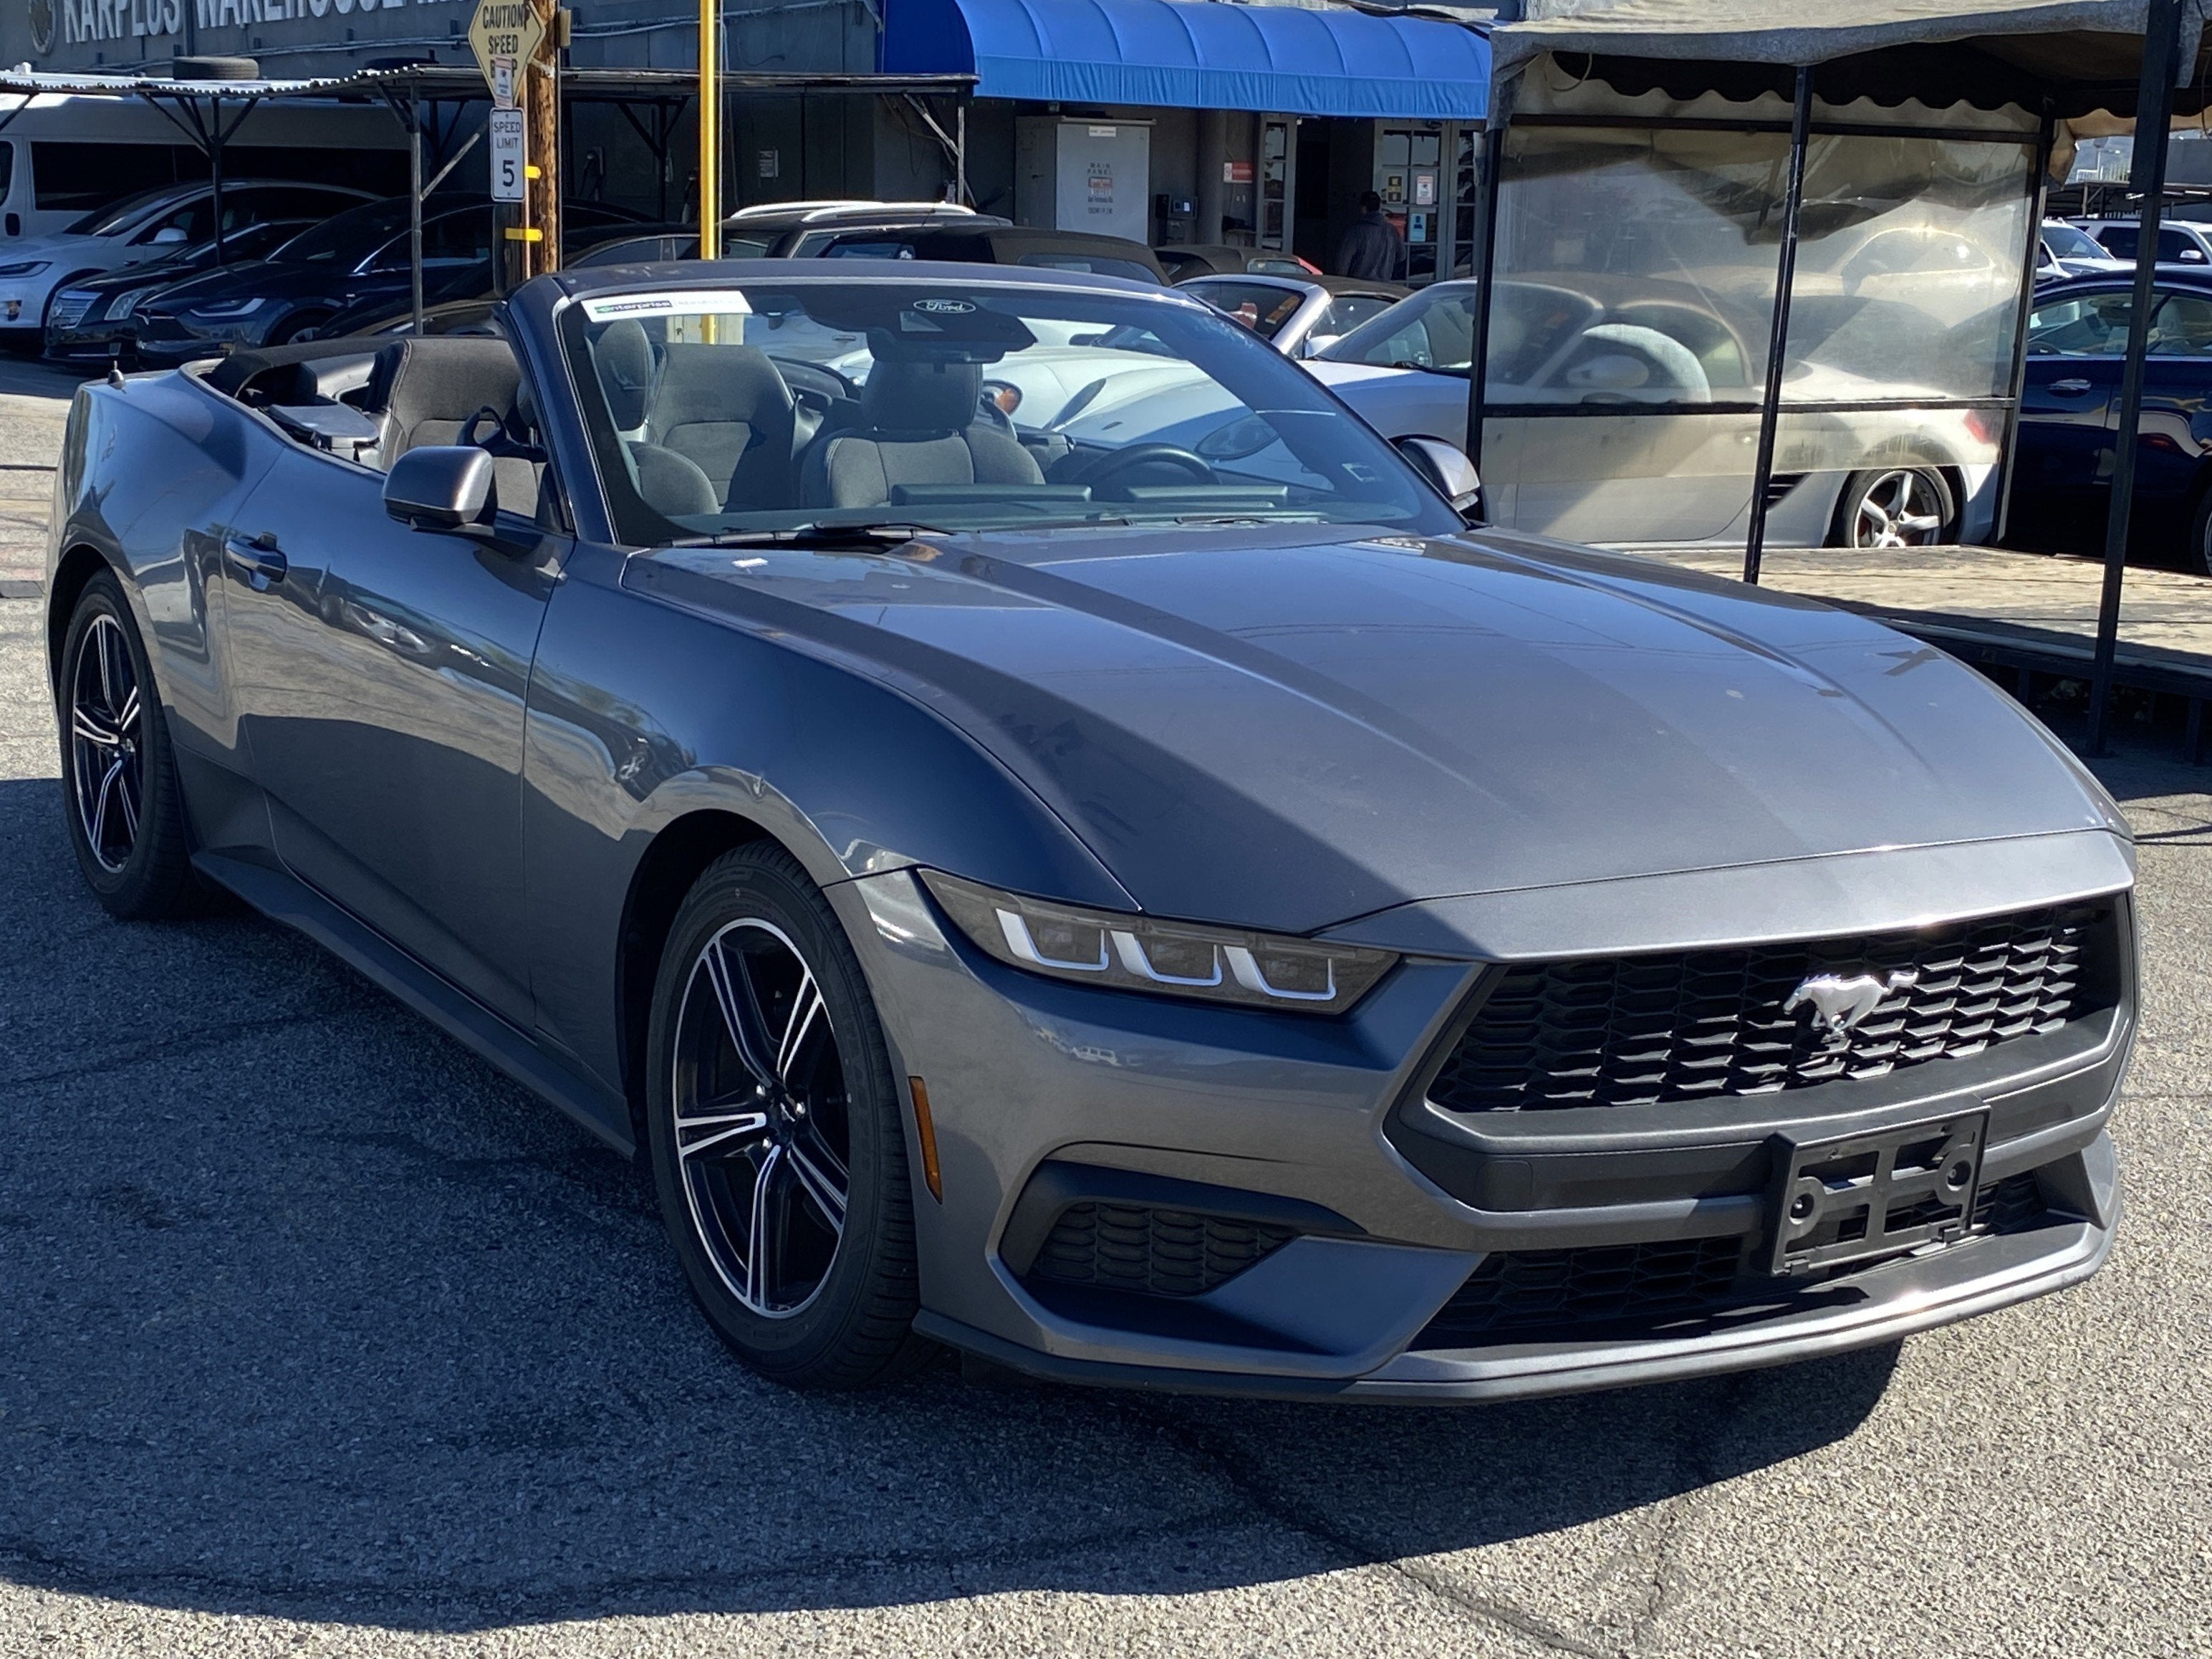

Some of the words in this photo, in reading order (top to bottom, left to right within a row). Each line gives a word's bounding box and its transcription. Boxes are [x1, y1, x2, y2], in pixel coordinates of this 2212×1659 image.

[482, 4, 524, 29] CAUTION
[488, 34, 519, 54] SPEED
[494, 121, 521, 133] SPEED
[496, 137, 519, 149] LIMIT
[502, 159, 515, 187] 5
[926, 301, 966, 311] Ford
